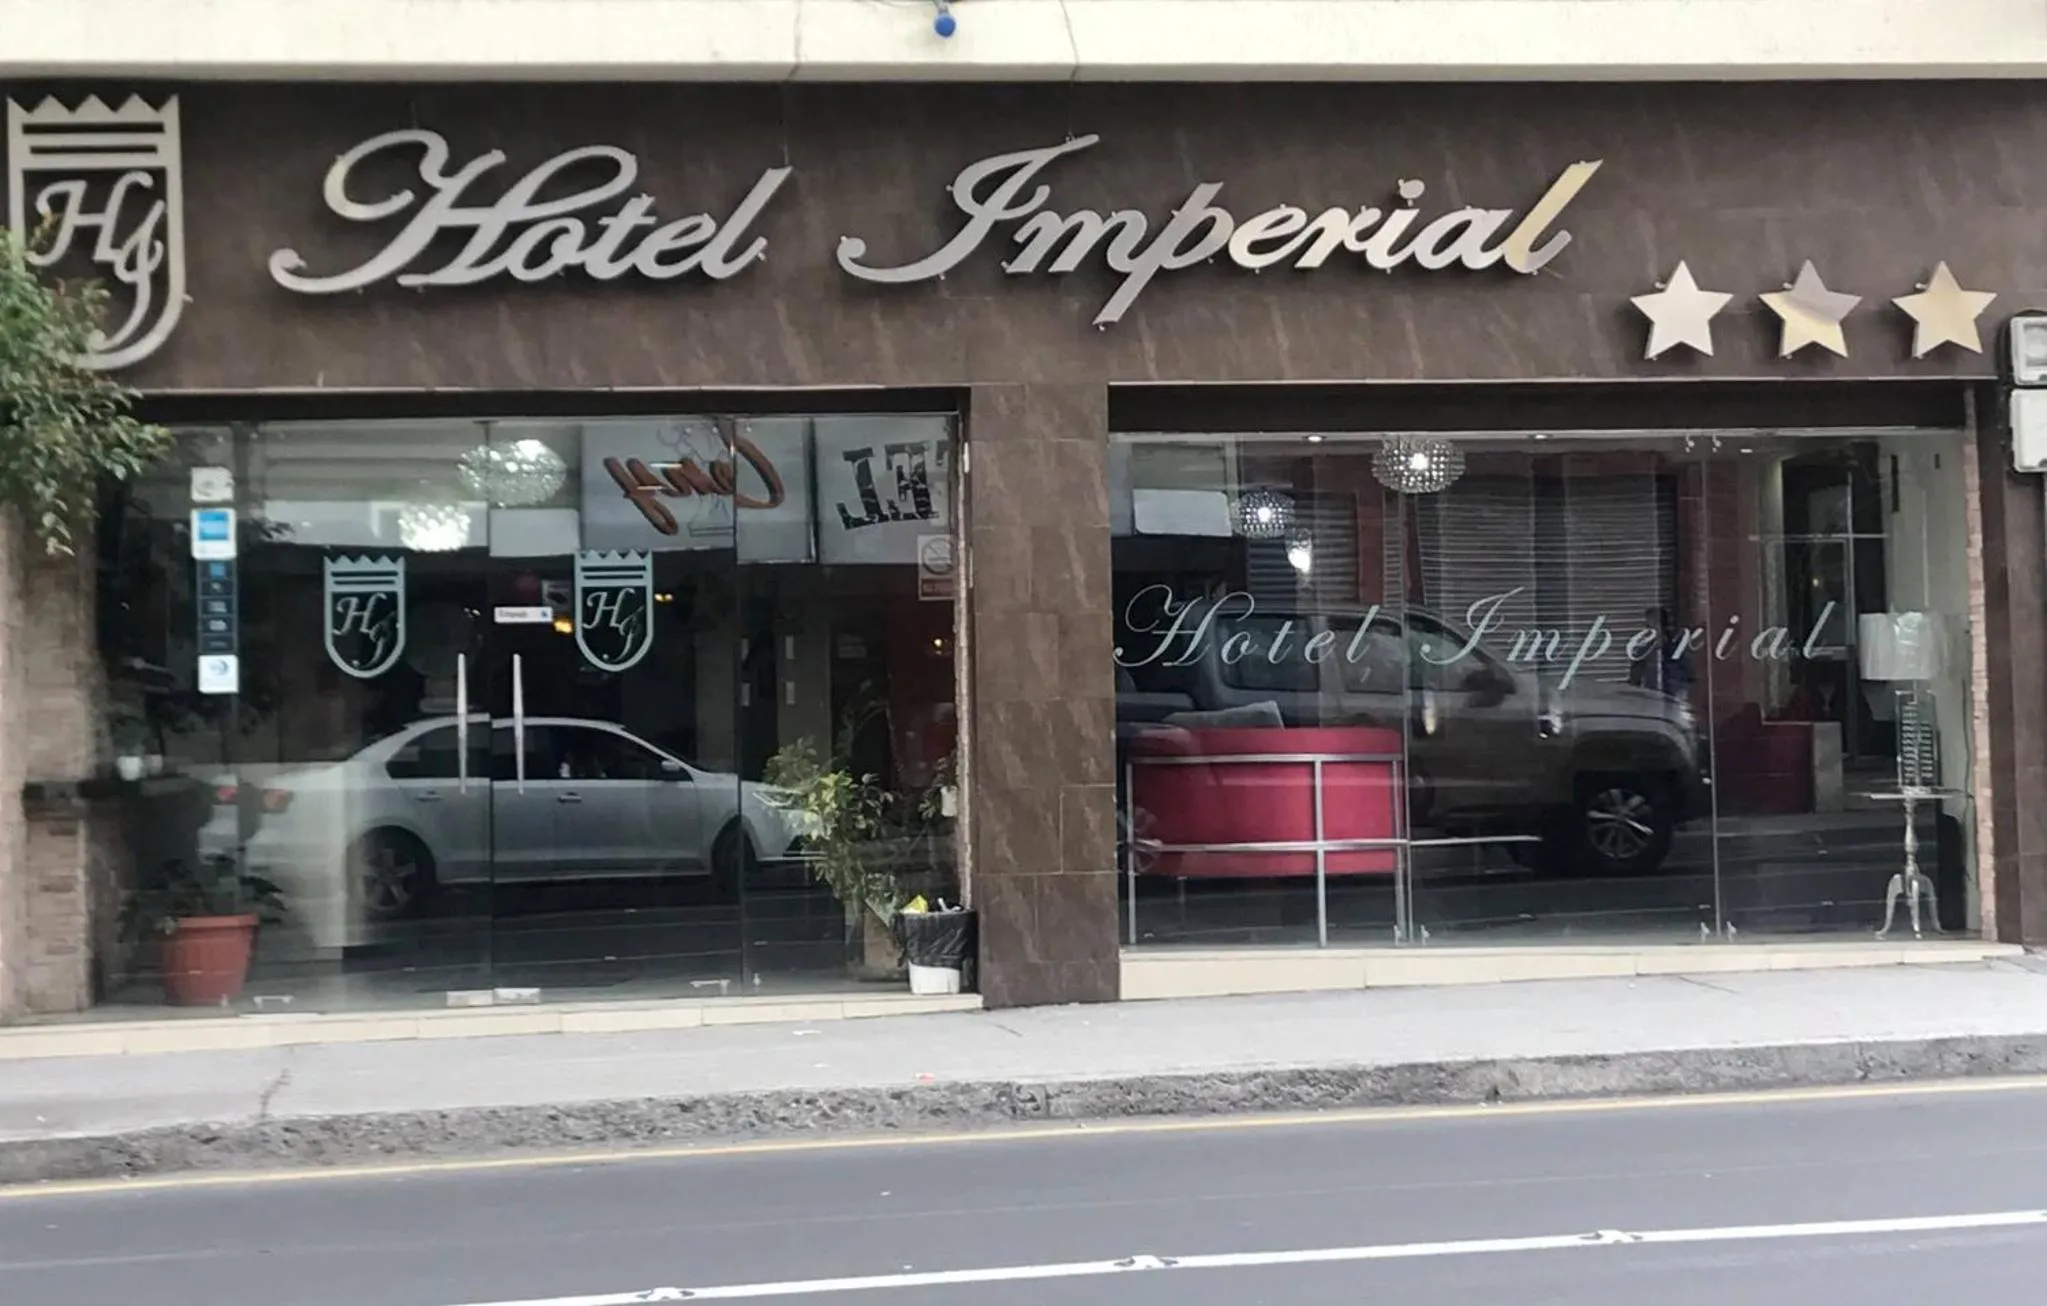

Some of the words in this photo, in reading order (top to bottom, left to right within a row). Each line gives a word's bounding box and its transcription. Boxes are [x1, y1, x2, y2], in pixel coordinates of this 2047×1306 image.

[268, 127, 794, 293] Hotel
[836, 133, 1603, 327] Imperial
[1112, 584, 1380, 667] Hotel
[1420, 586, 1837, 690] Imperial
